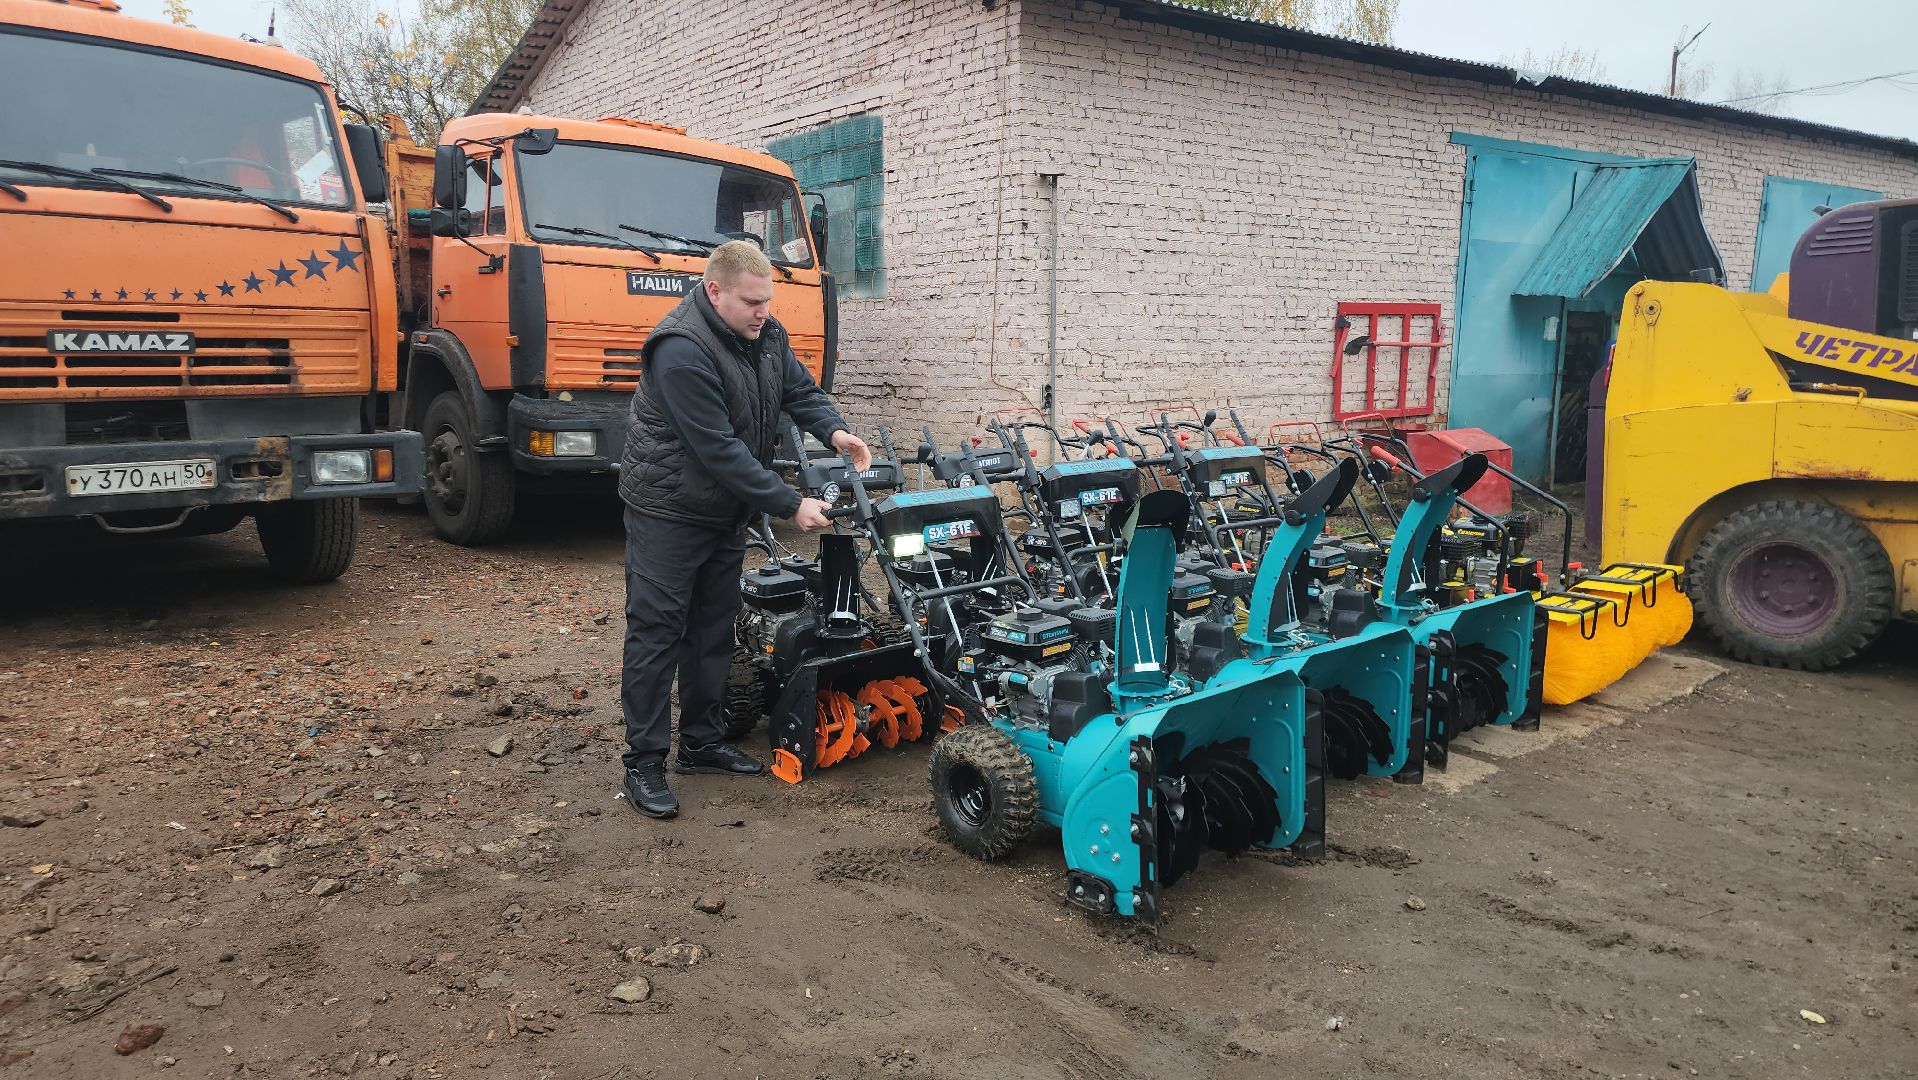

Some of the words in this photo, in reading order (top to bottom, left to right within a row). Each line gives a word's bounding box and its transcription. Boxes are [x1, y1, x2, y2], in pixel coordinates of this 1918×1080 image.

[632, 276, 683, 292] НАШИ
[54, 333, 190, 351] KAMAZ
[184, 464, 205, 479] 50
[928, 522, 972, 540] SX-61E
